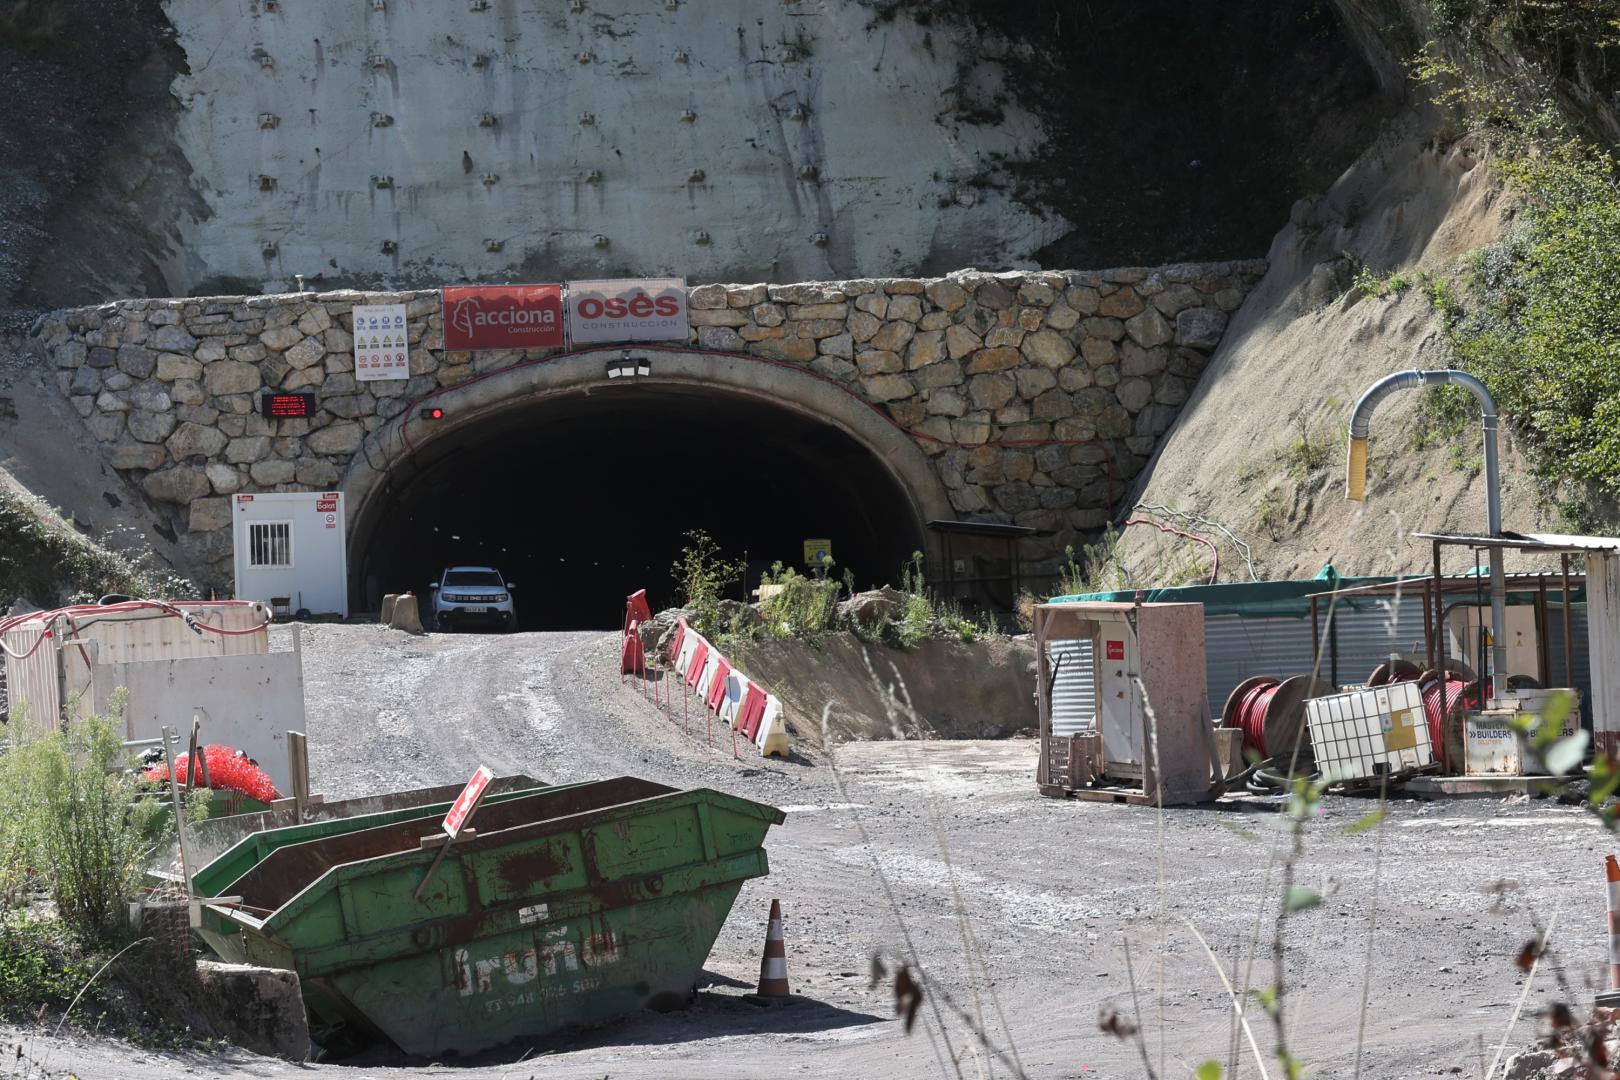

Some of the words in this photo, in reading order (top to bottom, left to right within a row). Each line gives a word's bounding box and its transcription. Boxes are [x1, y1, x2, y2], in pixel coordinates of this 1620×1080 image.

[475, 306, 555, 326] acciona
[582, 320, 678, 329] CONSTRUCCIÓN
[508, 326, 555, 334] Construcción
[1477, 730, 1512, 739] BUILDERS
